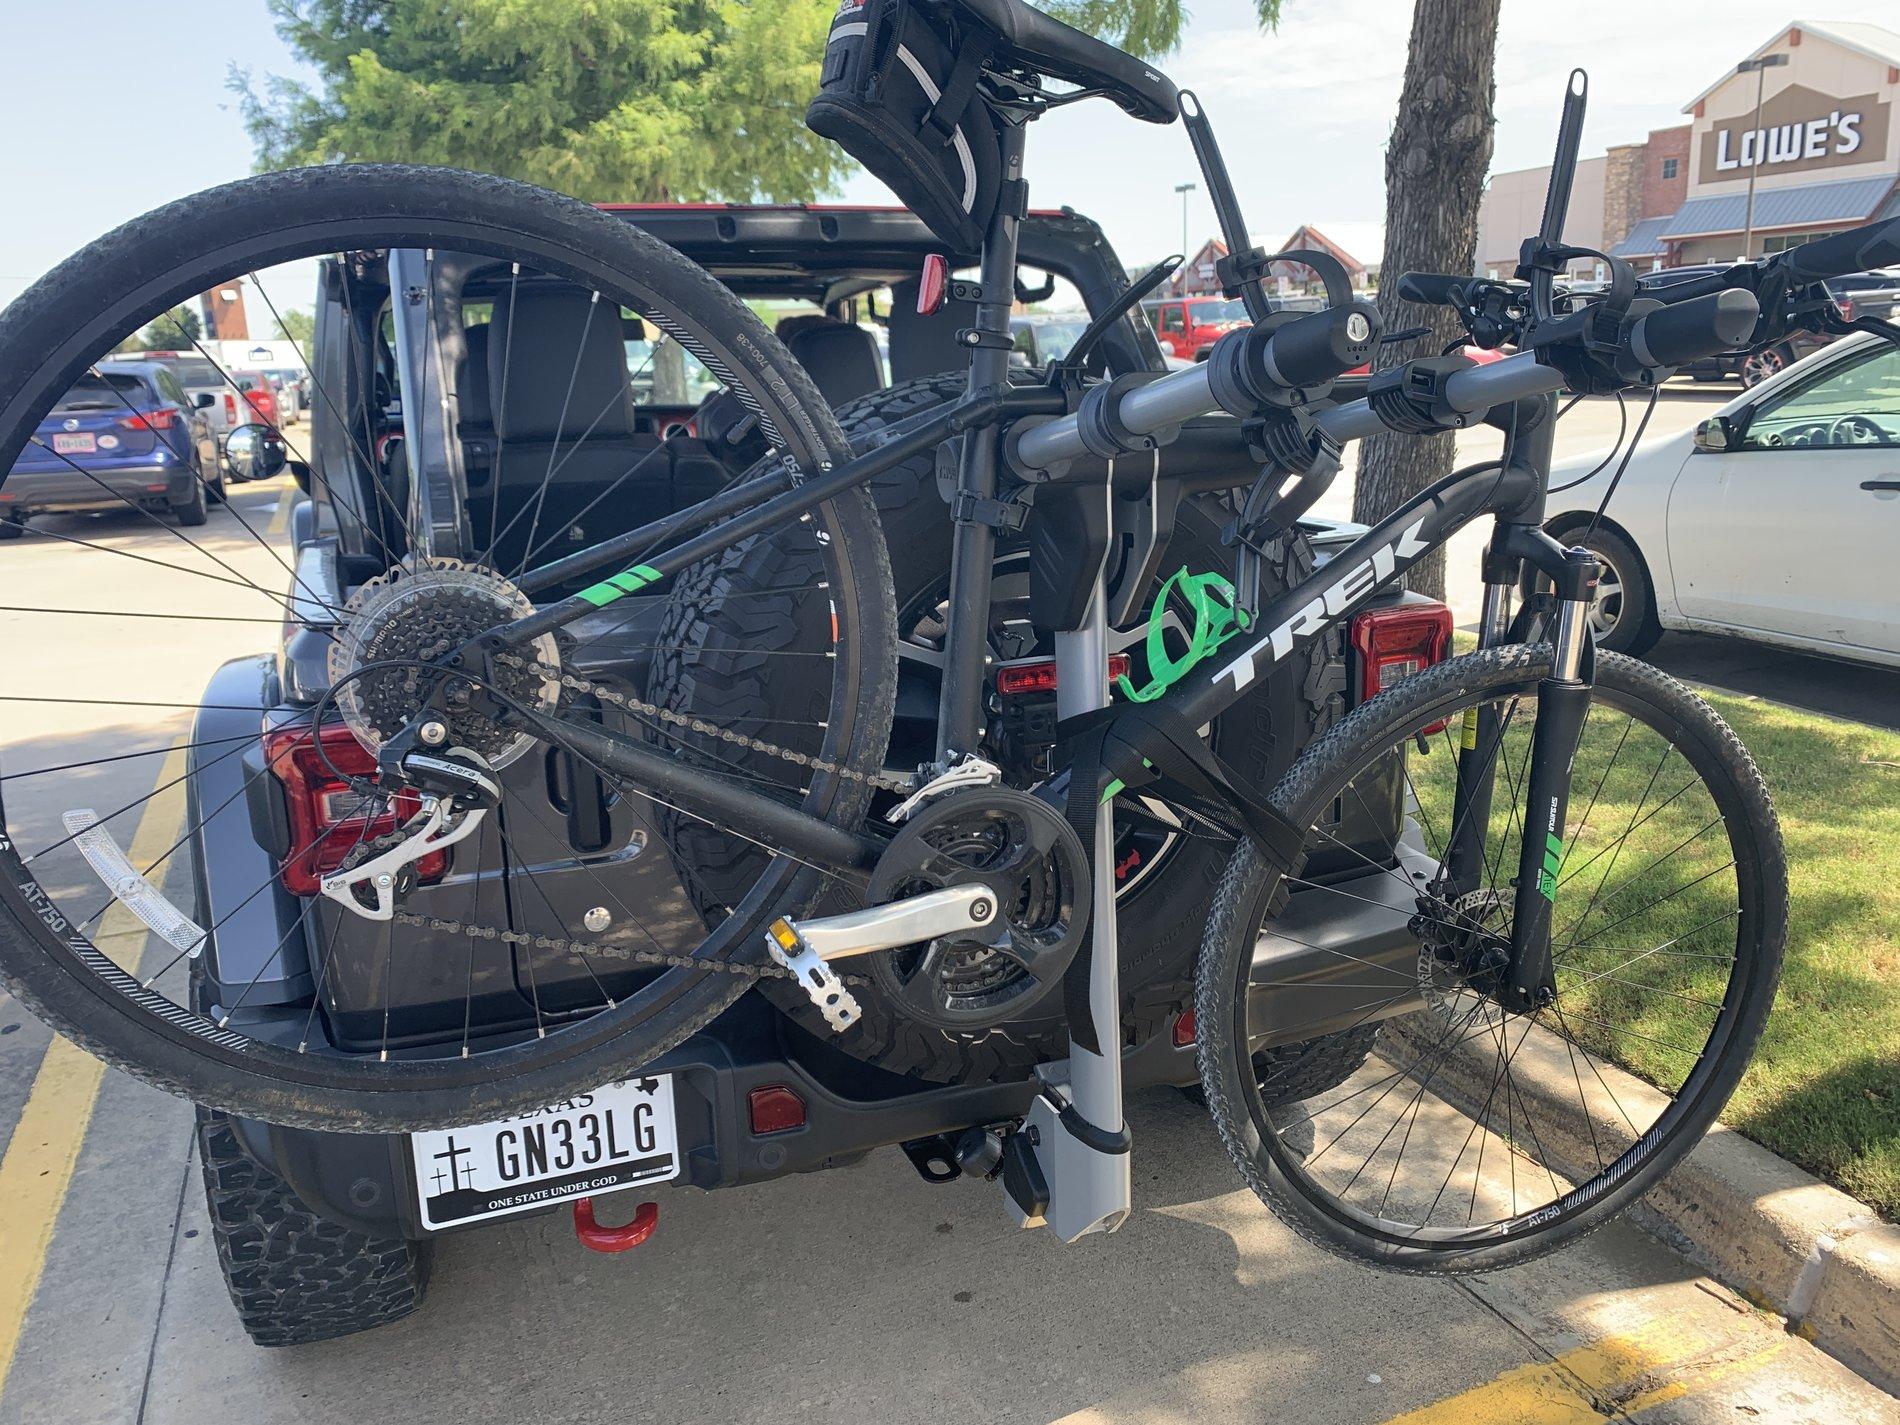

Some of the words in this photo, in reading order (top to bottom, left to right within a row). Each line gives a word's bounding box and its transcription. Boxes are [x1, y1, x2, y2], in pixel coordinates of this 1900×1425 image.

[1716, 110, 1861, 172] LOWE'S
[1211, 515, 1430, 692] TREK
[442, 763, 477, 778] Acera
[18, 881, 67, 934] AT-750
[495, 1103, 656, 1182] GN33LG
[488, 1198, 513, 1210] ONE
[514, 1189, 549, 1205] STATE
[551, 1181, 590, 1196] UNDER
[591, 1175, 618, 1187] GOD
[1527, 1205, 1561, 1227] AT-750
